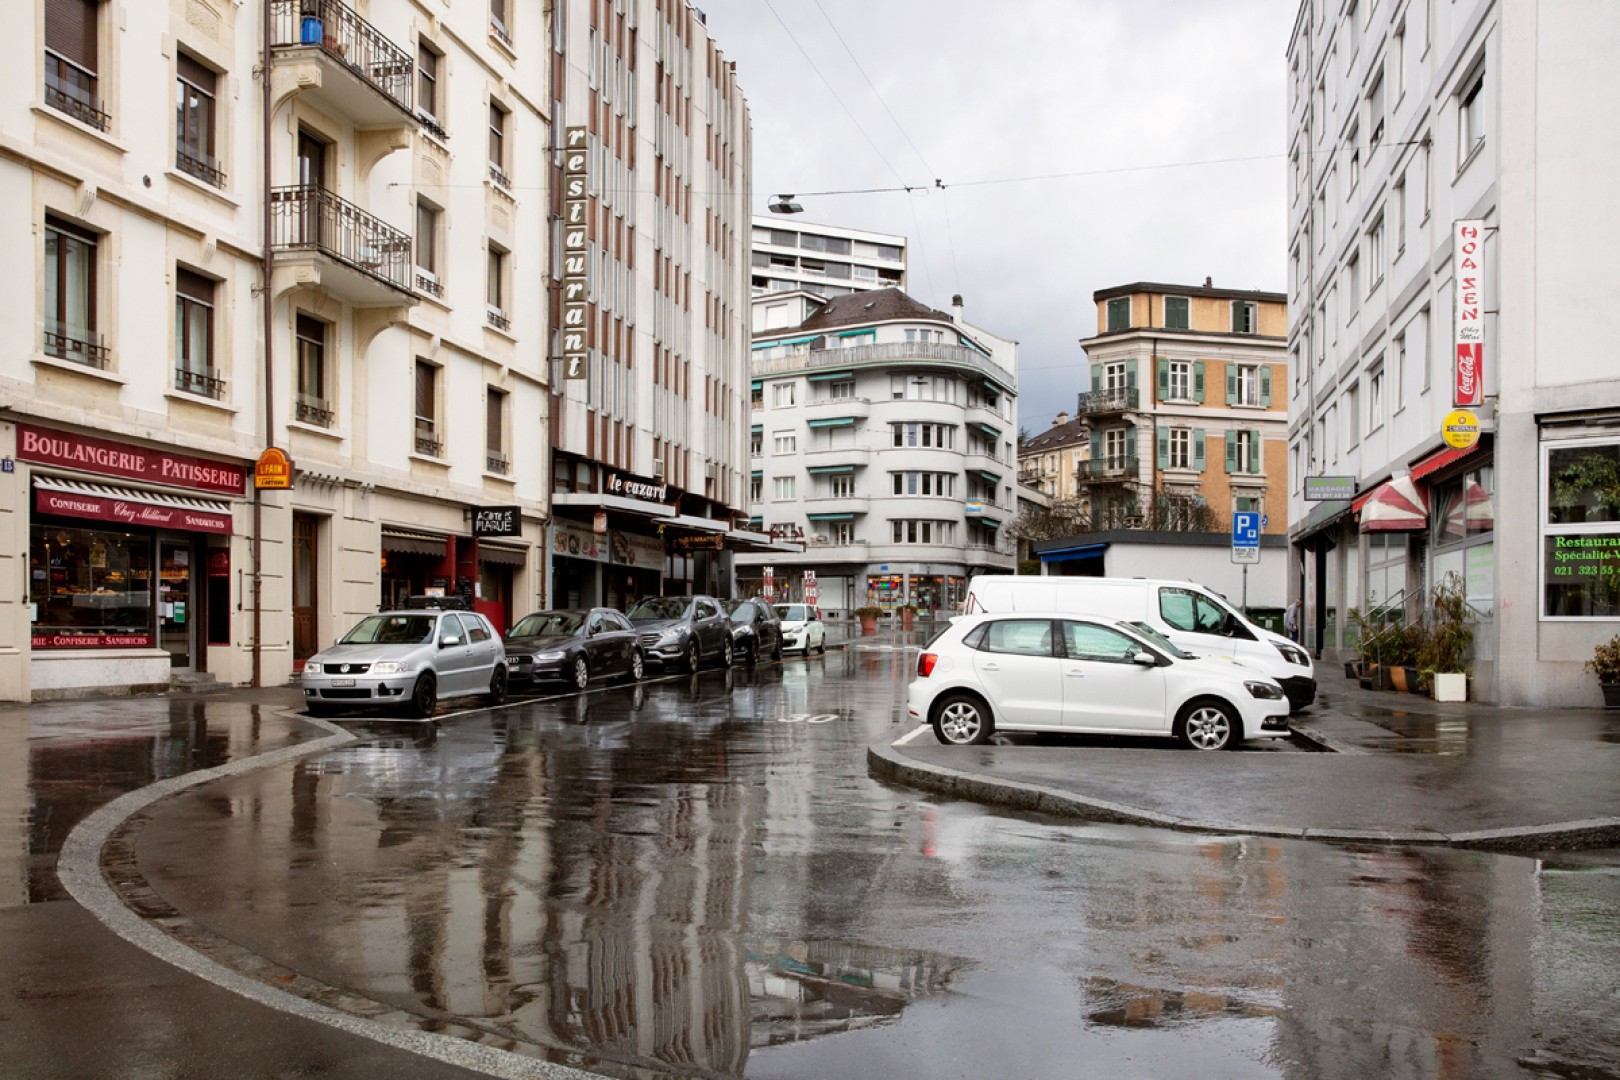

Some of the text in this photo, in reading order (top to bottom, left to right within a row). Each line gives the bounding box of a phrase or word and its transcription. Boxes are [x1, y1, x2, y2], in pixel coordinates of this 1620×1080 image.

[565, 130, 585, 376] restaurant
[1461, 227, 1478, 320] HOA SEN
[23, 431, 145, 472] BOULANGERIE
[161, 458, 240, 487] PATISSERIE
[609, 473, 667, 500] le cazard
[49, 498, 100, 513] CONFISERIE
[114, 501, 136, 521] Chez
[185, 515, 224, 528] SANDWICHS
[1237, 515, 1250, 534] P
[1554, 566, 1573, 576] 021
[1578, 566, 1598, 575] 323
[53, 636, 99, 646] CONFISERIE
[106, 636, 147, 645] SANDWICHS
